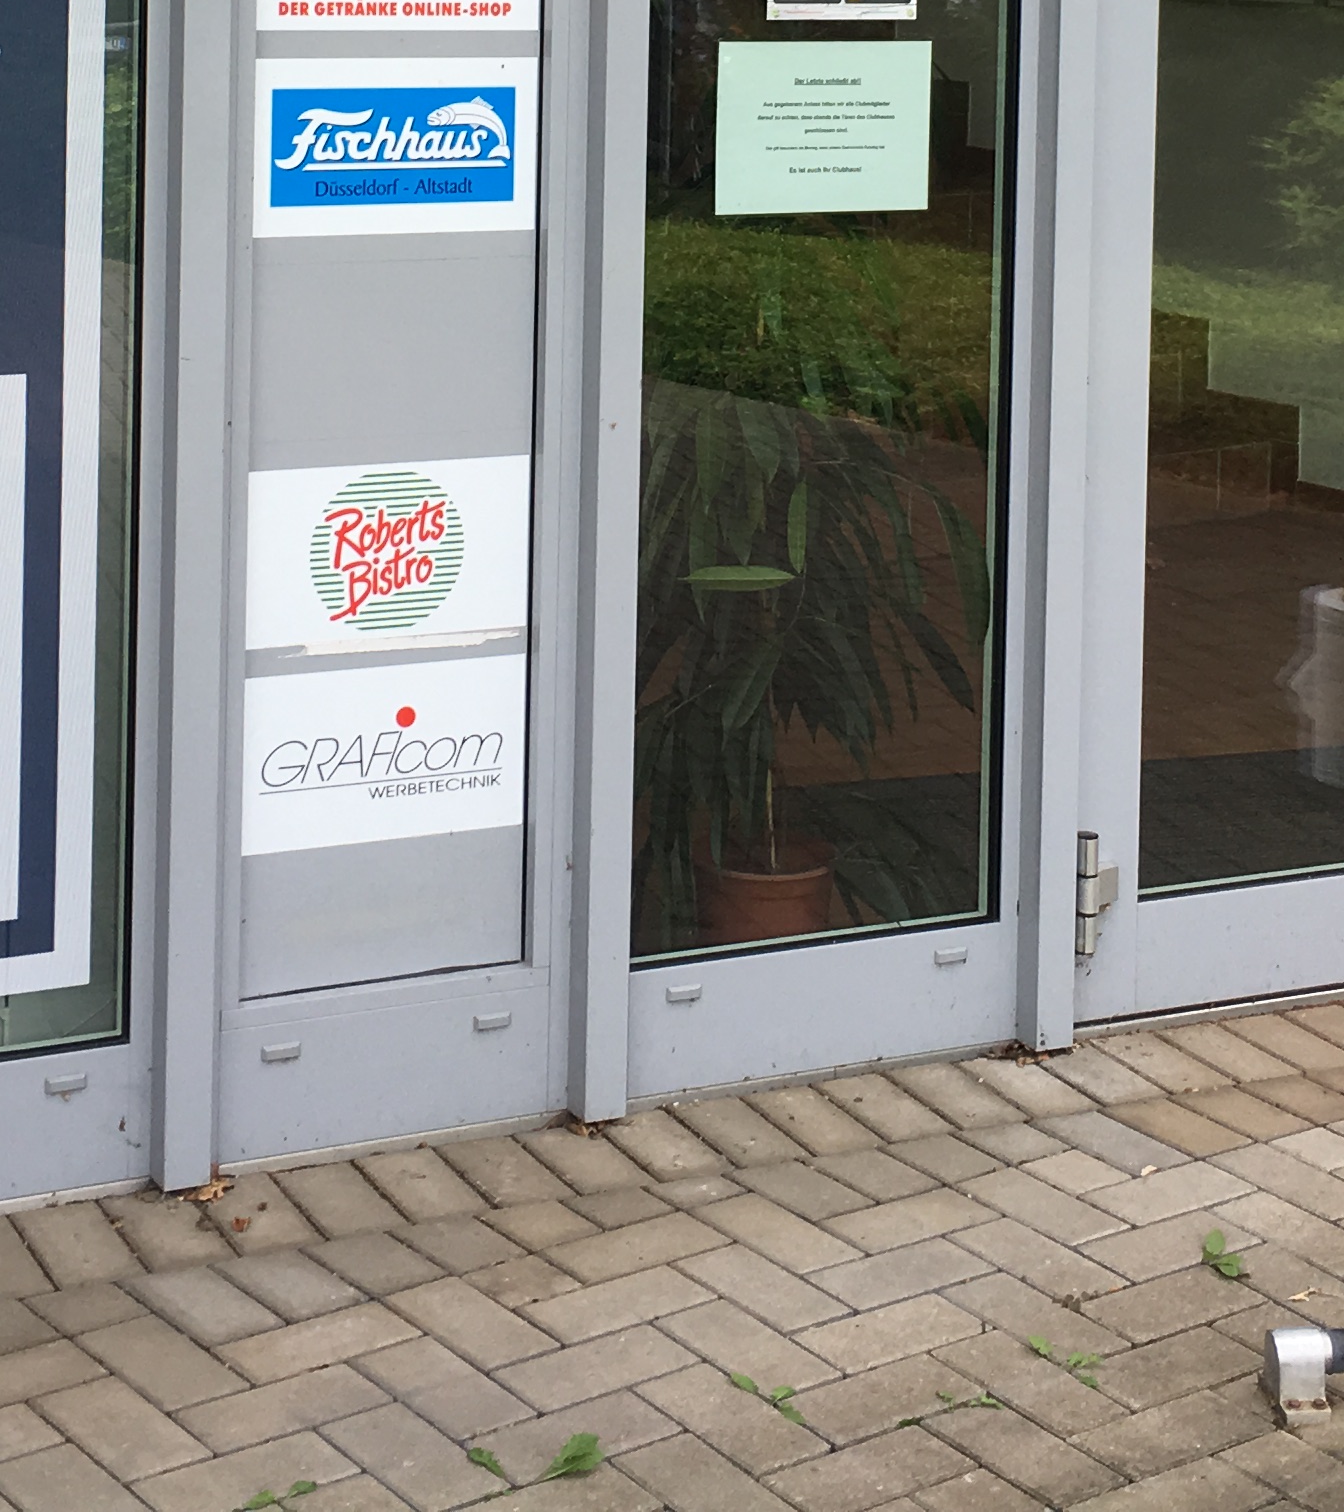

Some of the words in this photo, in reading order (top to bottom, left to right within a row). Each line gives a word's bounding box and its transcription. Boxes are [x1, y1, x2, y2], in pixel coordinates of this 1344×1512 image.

[278, 1, 309, 17] DER
[402, 1, 512, 17] ONLINE-SHOP
[274, 108, 488, 170] Fischhaus
[315, 179, 400, 197] Düsseldorf
[414, 177, 473, 195] Altstadt
[325, 499, 445, 569] Roberts
[329, 548, 433, 622] Bistro
[368, 774, 502, 800] WERBETECHNIK
